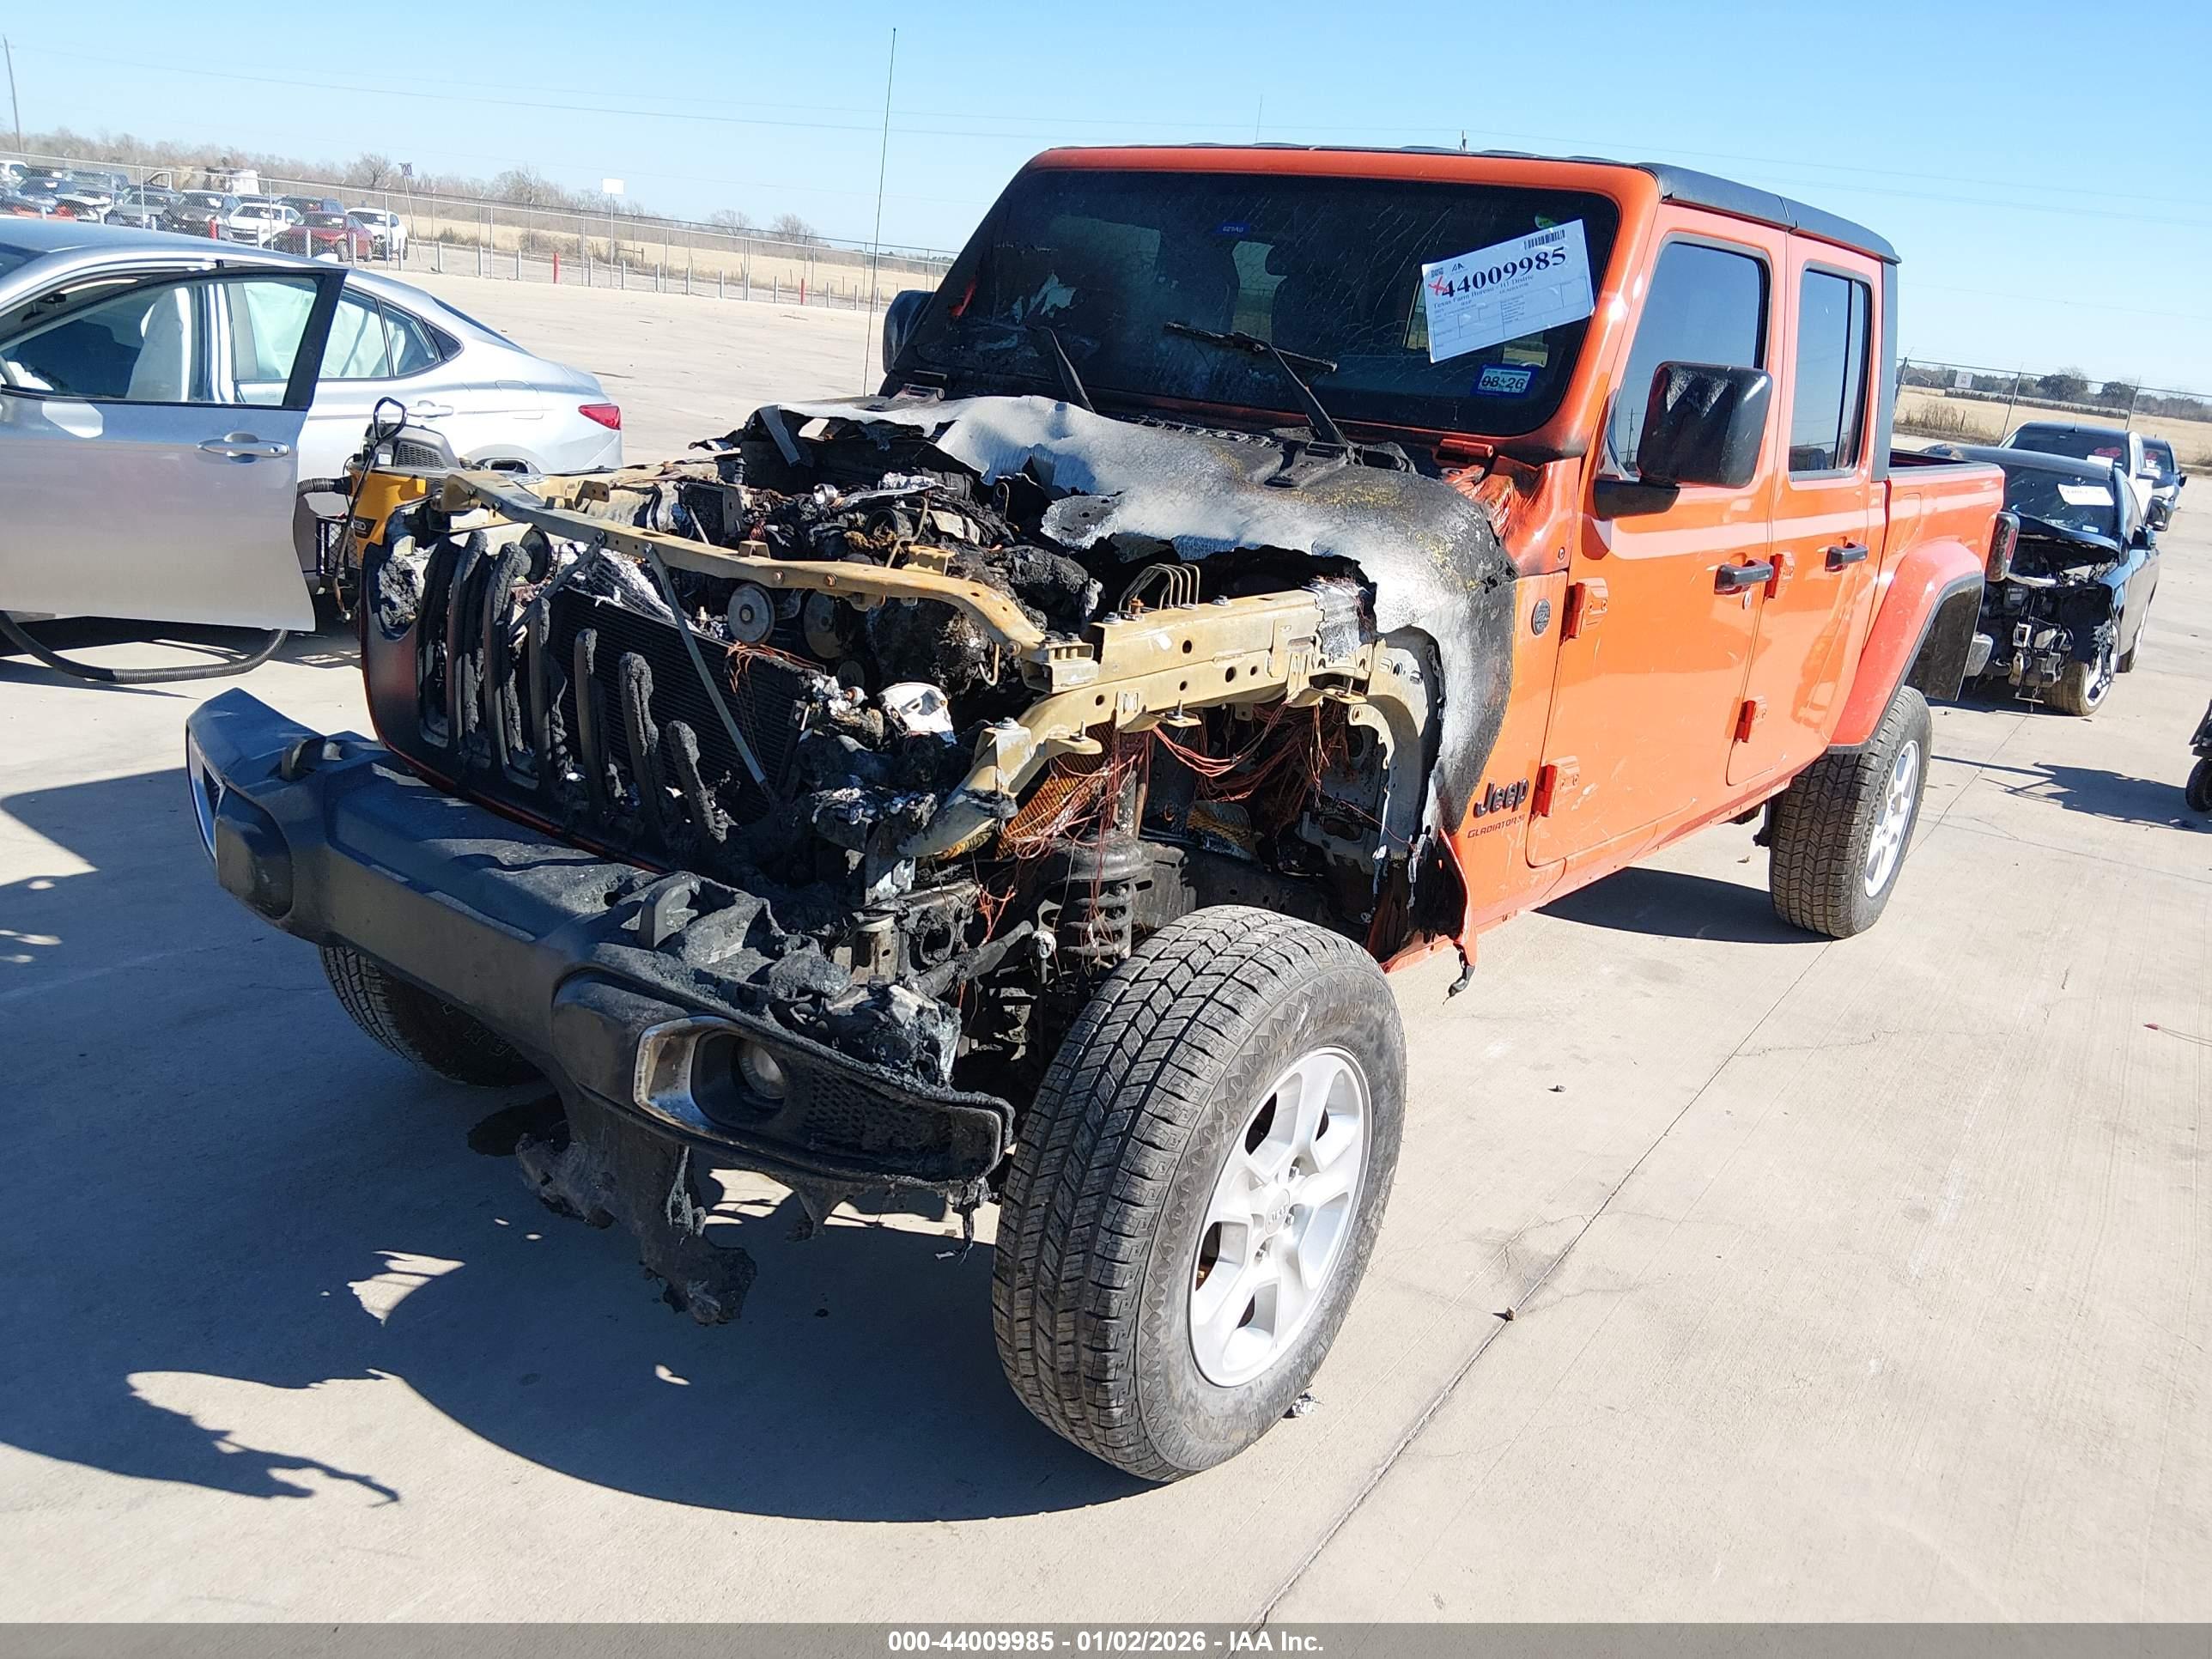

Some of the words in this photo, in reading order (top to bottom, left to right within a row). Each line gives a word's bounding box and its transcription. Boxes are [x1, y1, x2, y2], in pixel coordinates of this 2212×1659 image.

[1441, 246, 1566, 298] 44009985
[1473, 778, 1529, 818] Jeep
[1467, 817, 1518, 839] GLADIATOR
